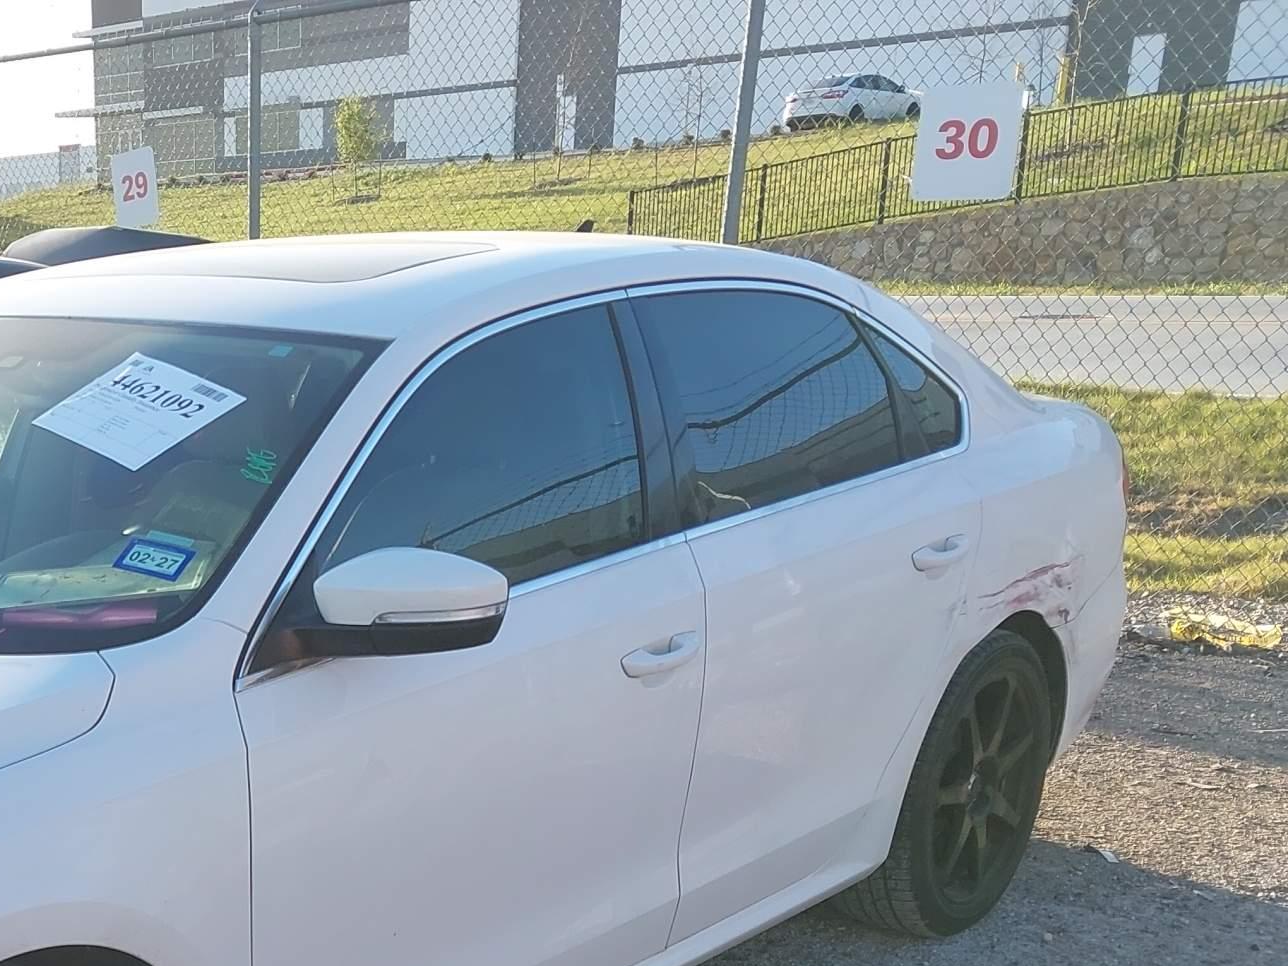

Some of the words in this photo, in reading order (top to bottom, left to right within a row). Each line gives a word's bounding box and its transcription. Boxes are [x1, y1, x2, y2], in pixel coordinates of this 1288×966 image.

[935, 117, 999, 160] 30
[121, 171, 148, 202] 29
[111, 374, 205, 418] 44621092
